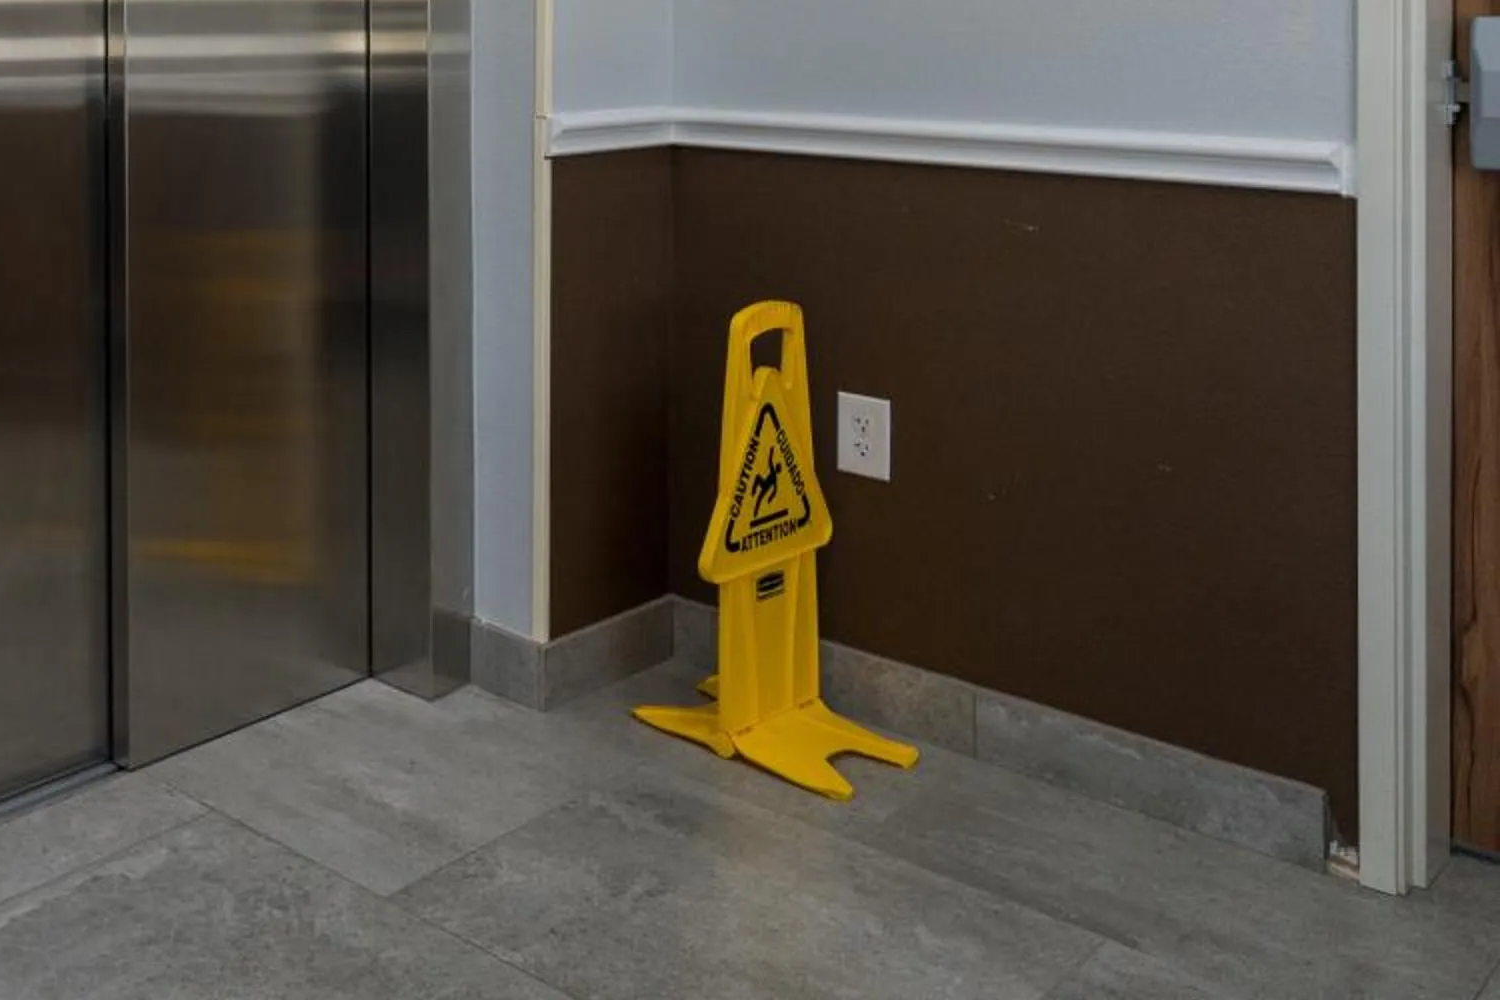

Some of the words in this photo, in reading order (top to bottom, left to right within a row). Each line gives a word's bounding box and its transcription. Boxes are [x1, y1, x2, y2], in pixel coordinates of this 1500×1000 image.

[730, 438, 760, 518] CAUTION
[776, 430, 805, 495] CUIDADO
[739, 520, 797, 552] ATTENTION
